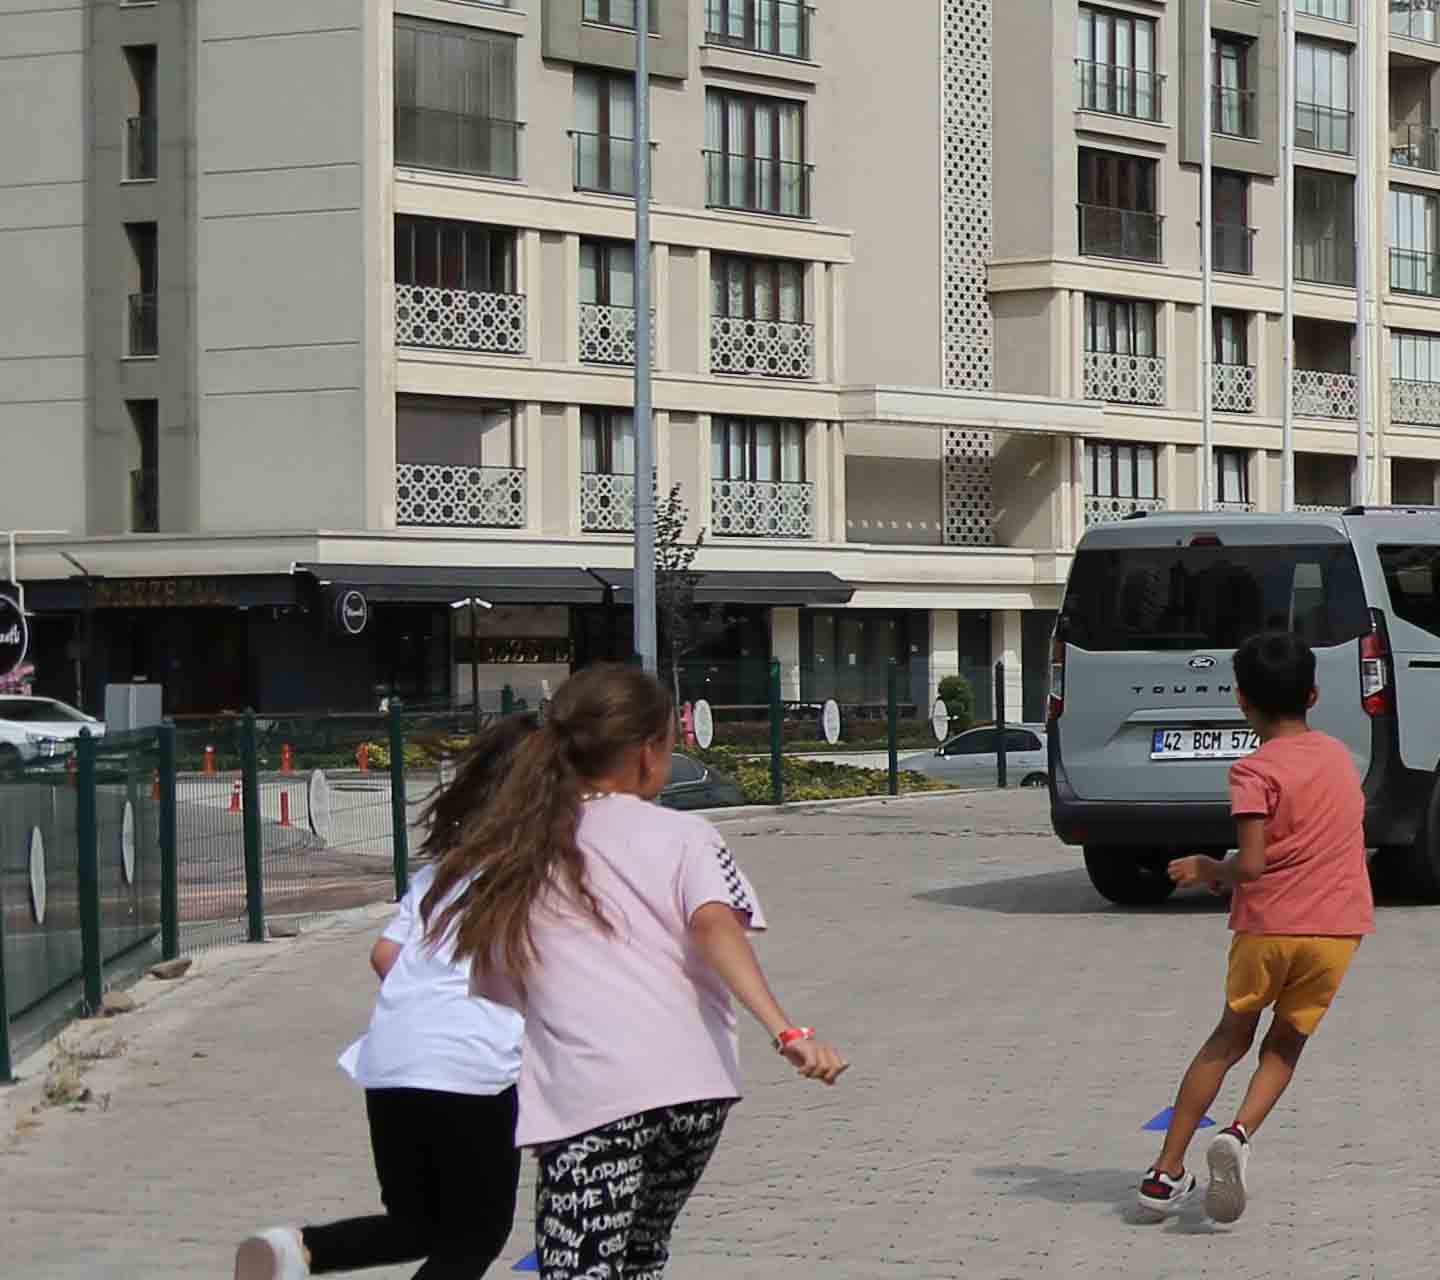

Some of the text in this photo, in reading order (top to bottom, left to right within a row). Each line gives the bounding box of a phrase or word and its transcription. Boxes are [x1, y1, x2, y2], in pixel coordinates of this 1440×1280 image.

[1132, 685, 1232, 694] TOURN
[1164, 732, 1182, 751] 42
[551, 1188, 603, 1218] ROME
